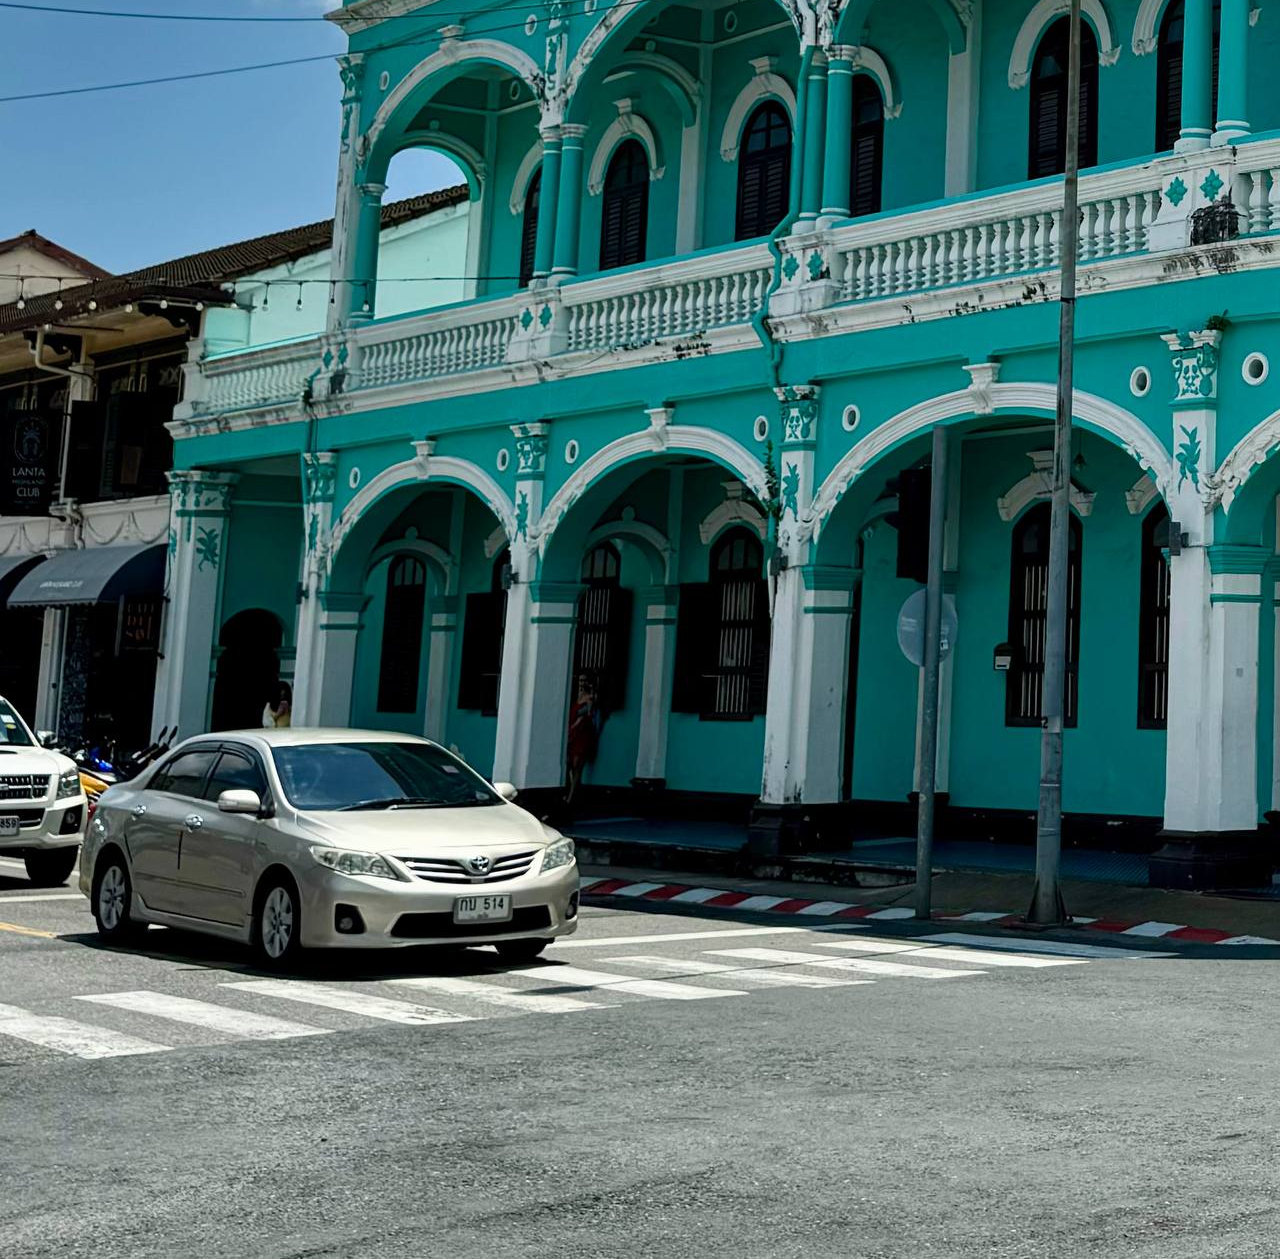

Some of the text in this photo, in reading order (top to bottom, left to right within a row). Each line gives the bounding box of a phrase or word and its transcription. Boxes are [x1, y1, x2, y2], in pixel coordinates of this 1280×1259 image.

[12, 467, 46, 477] LANTA
[16, 487, 41, 497] CLUB
[484, 897, 504, 910] 514
